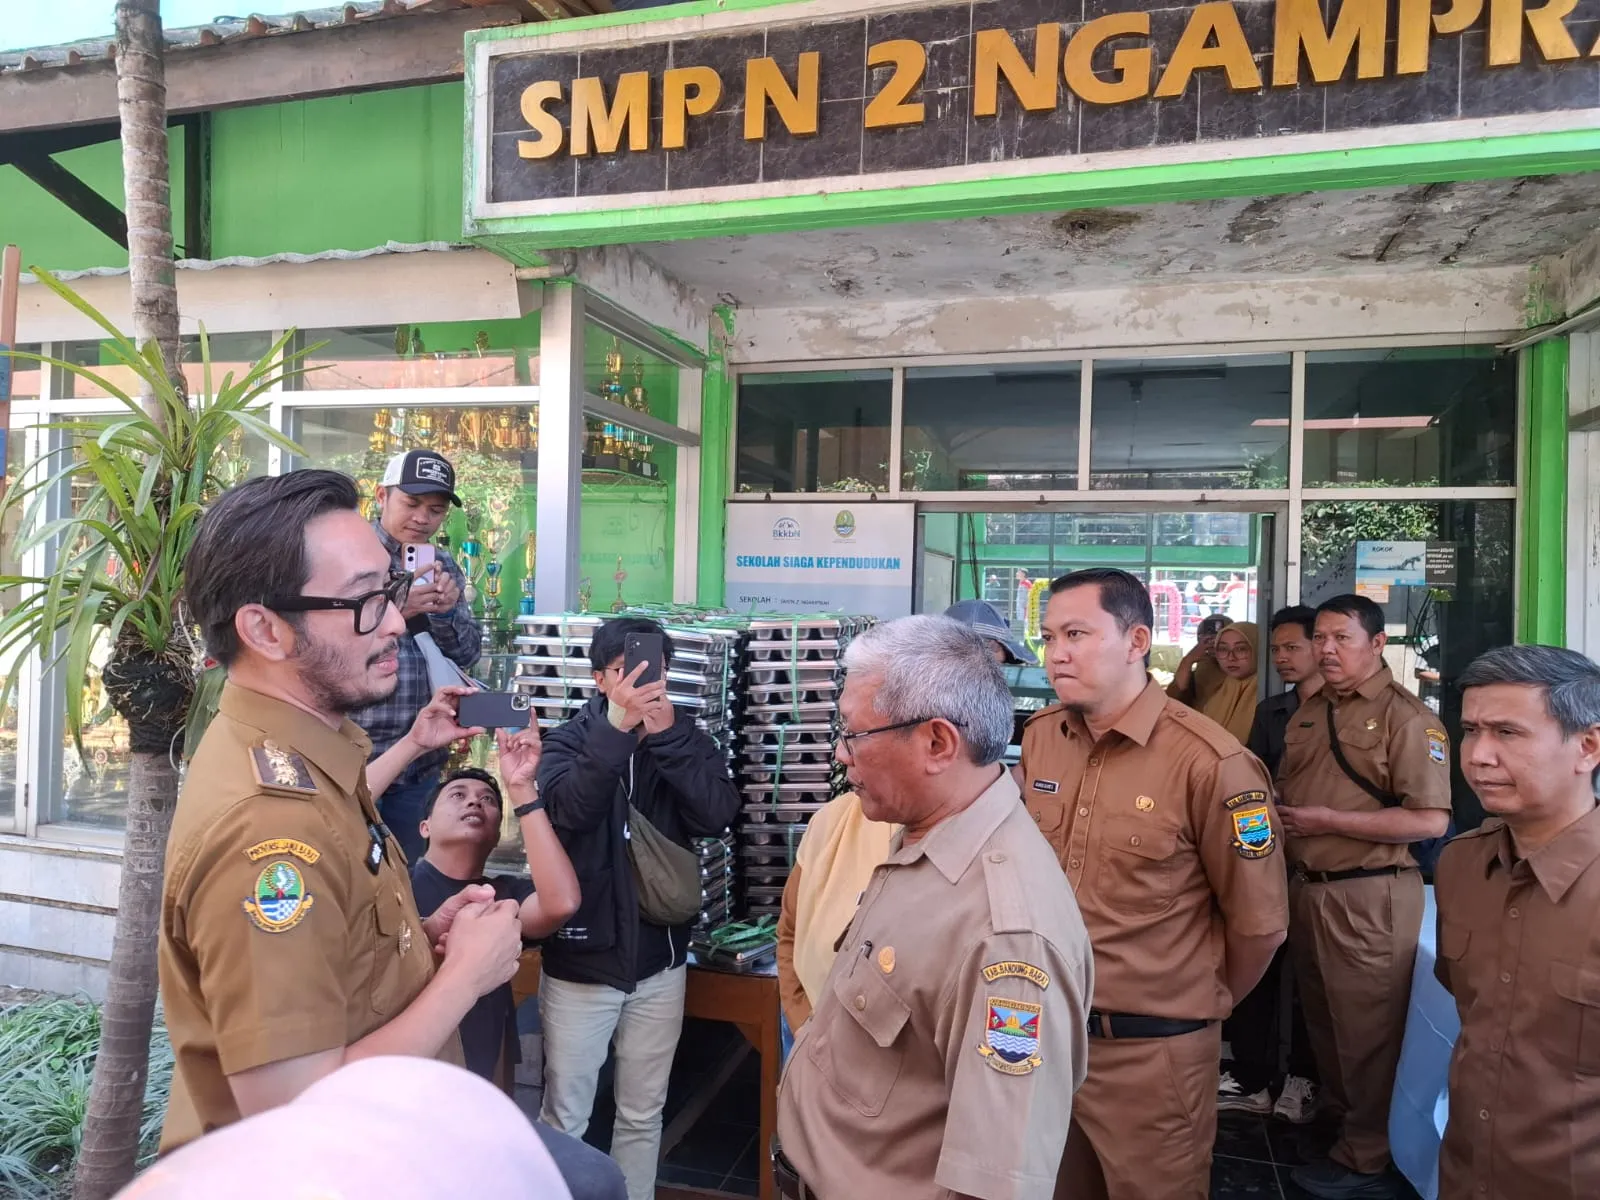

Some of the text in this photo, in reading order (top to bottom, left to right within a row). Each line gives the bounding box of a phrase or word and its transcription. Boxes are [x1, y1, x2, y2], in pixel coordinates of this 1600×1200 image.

[517, 0, 1600, 160] SMPN 2 NGAMPR
[736, 555, 901, 570] SEKOLAH SIAGA KEPENDUDUKAN
